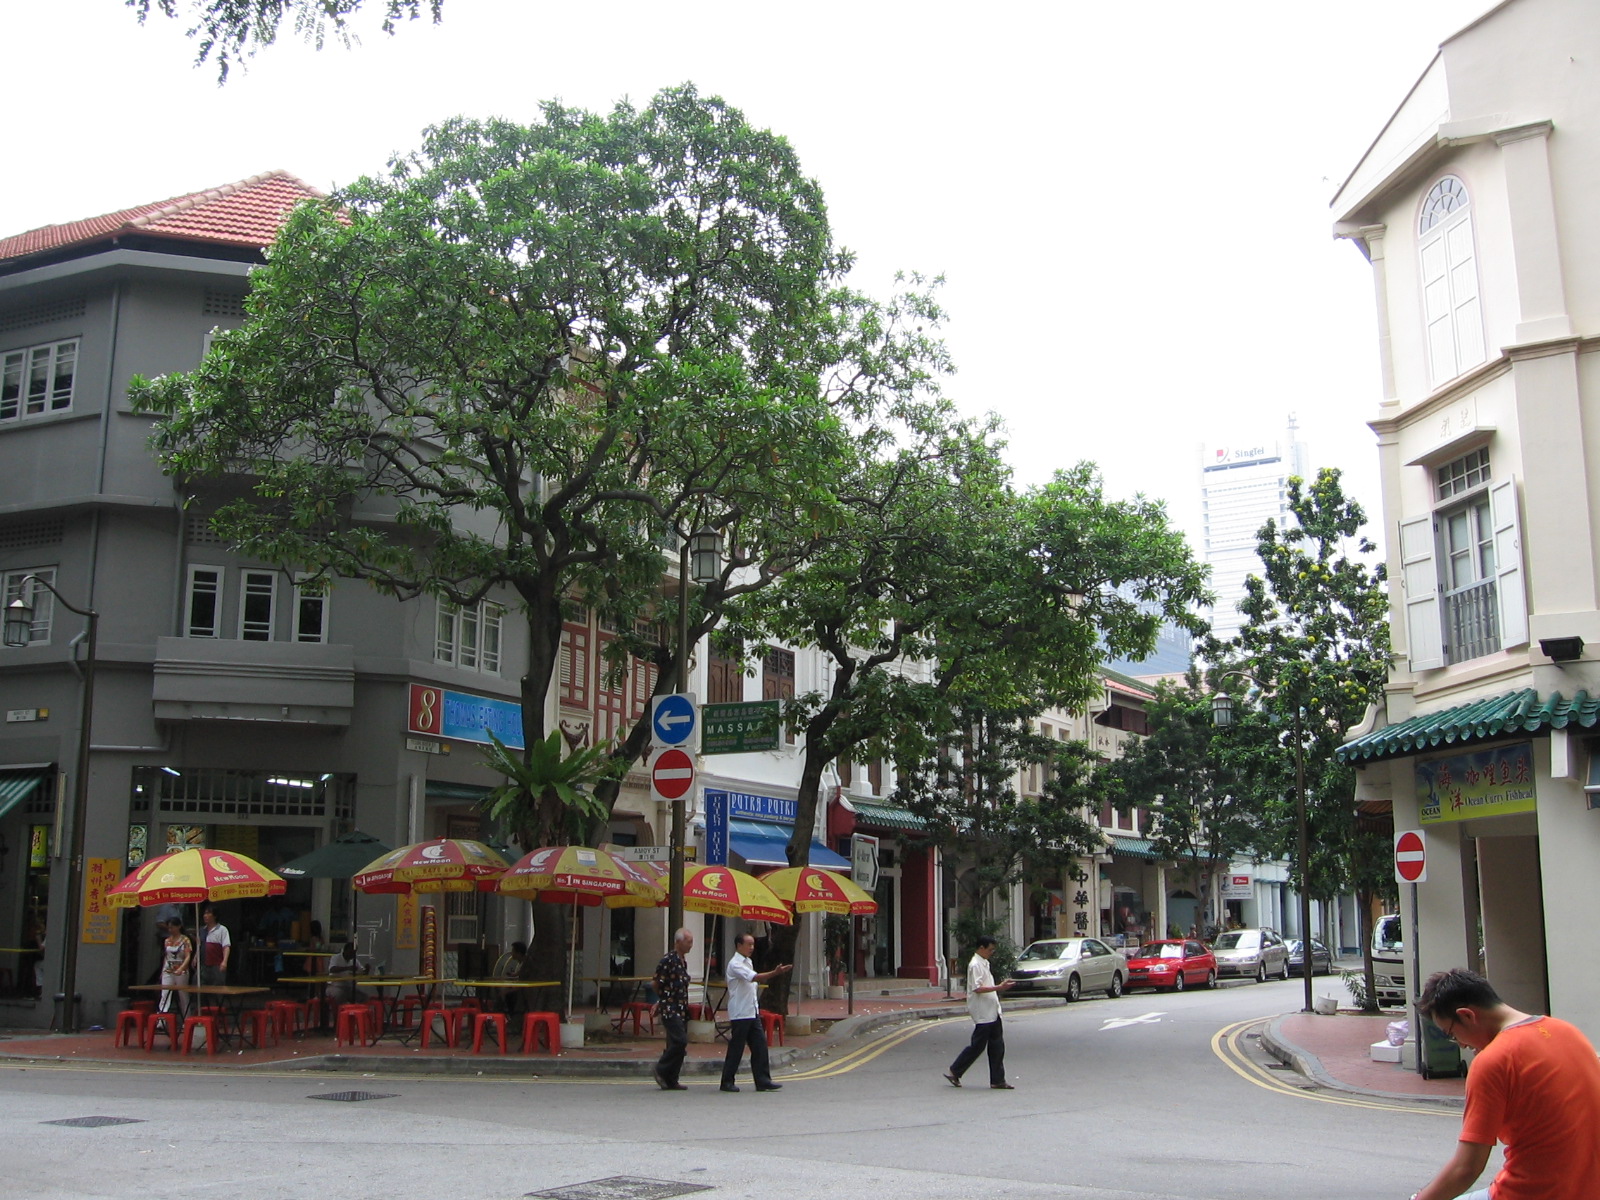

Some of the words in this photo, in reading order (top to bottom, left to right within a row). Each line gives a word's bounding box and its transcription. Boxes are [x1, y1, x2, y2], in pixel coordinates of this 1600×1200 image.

[1235, 446, 1265, 458] SingTel
[416, 689, 436, 731] 8
[446, 700, 476, 729] THOMAS
[1465, 795, 1485, 807] Ocean
[1485, 793, 1504, 806] Curry
[1421, 807, 1440, 816] OCEAN
[634, 847, 650, 855] AMOY
[214, 874, 249, 882] NewMoon
[582, 880, 622, 890] SINGAPORE
[692, 888, 728, 898] NewMoon
[761, 909, 785, 919] Singapore
